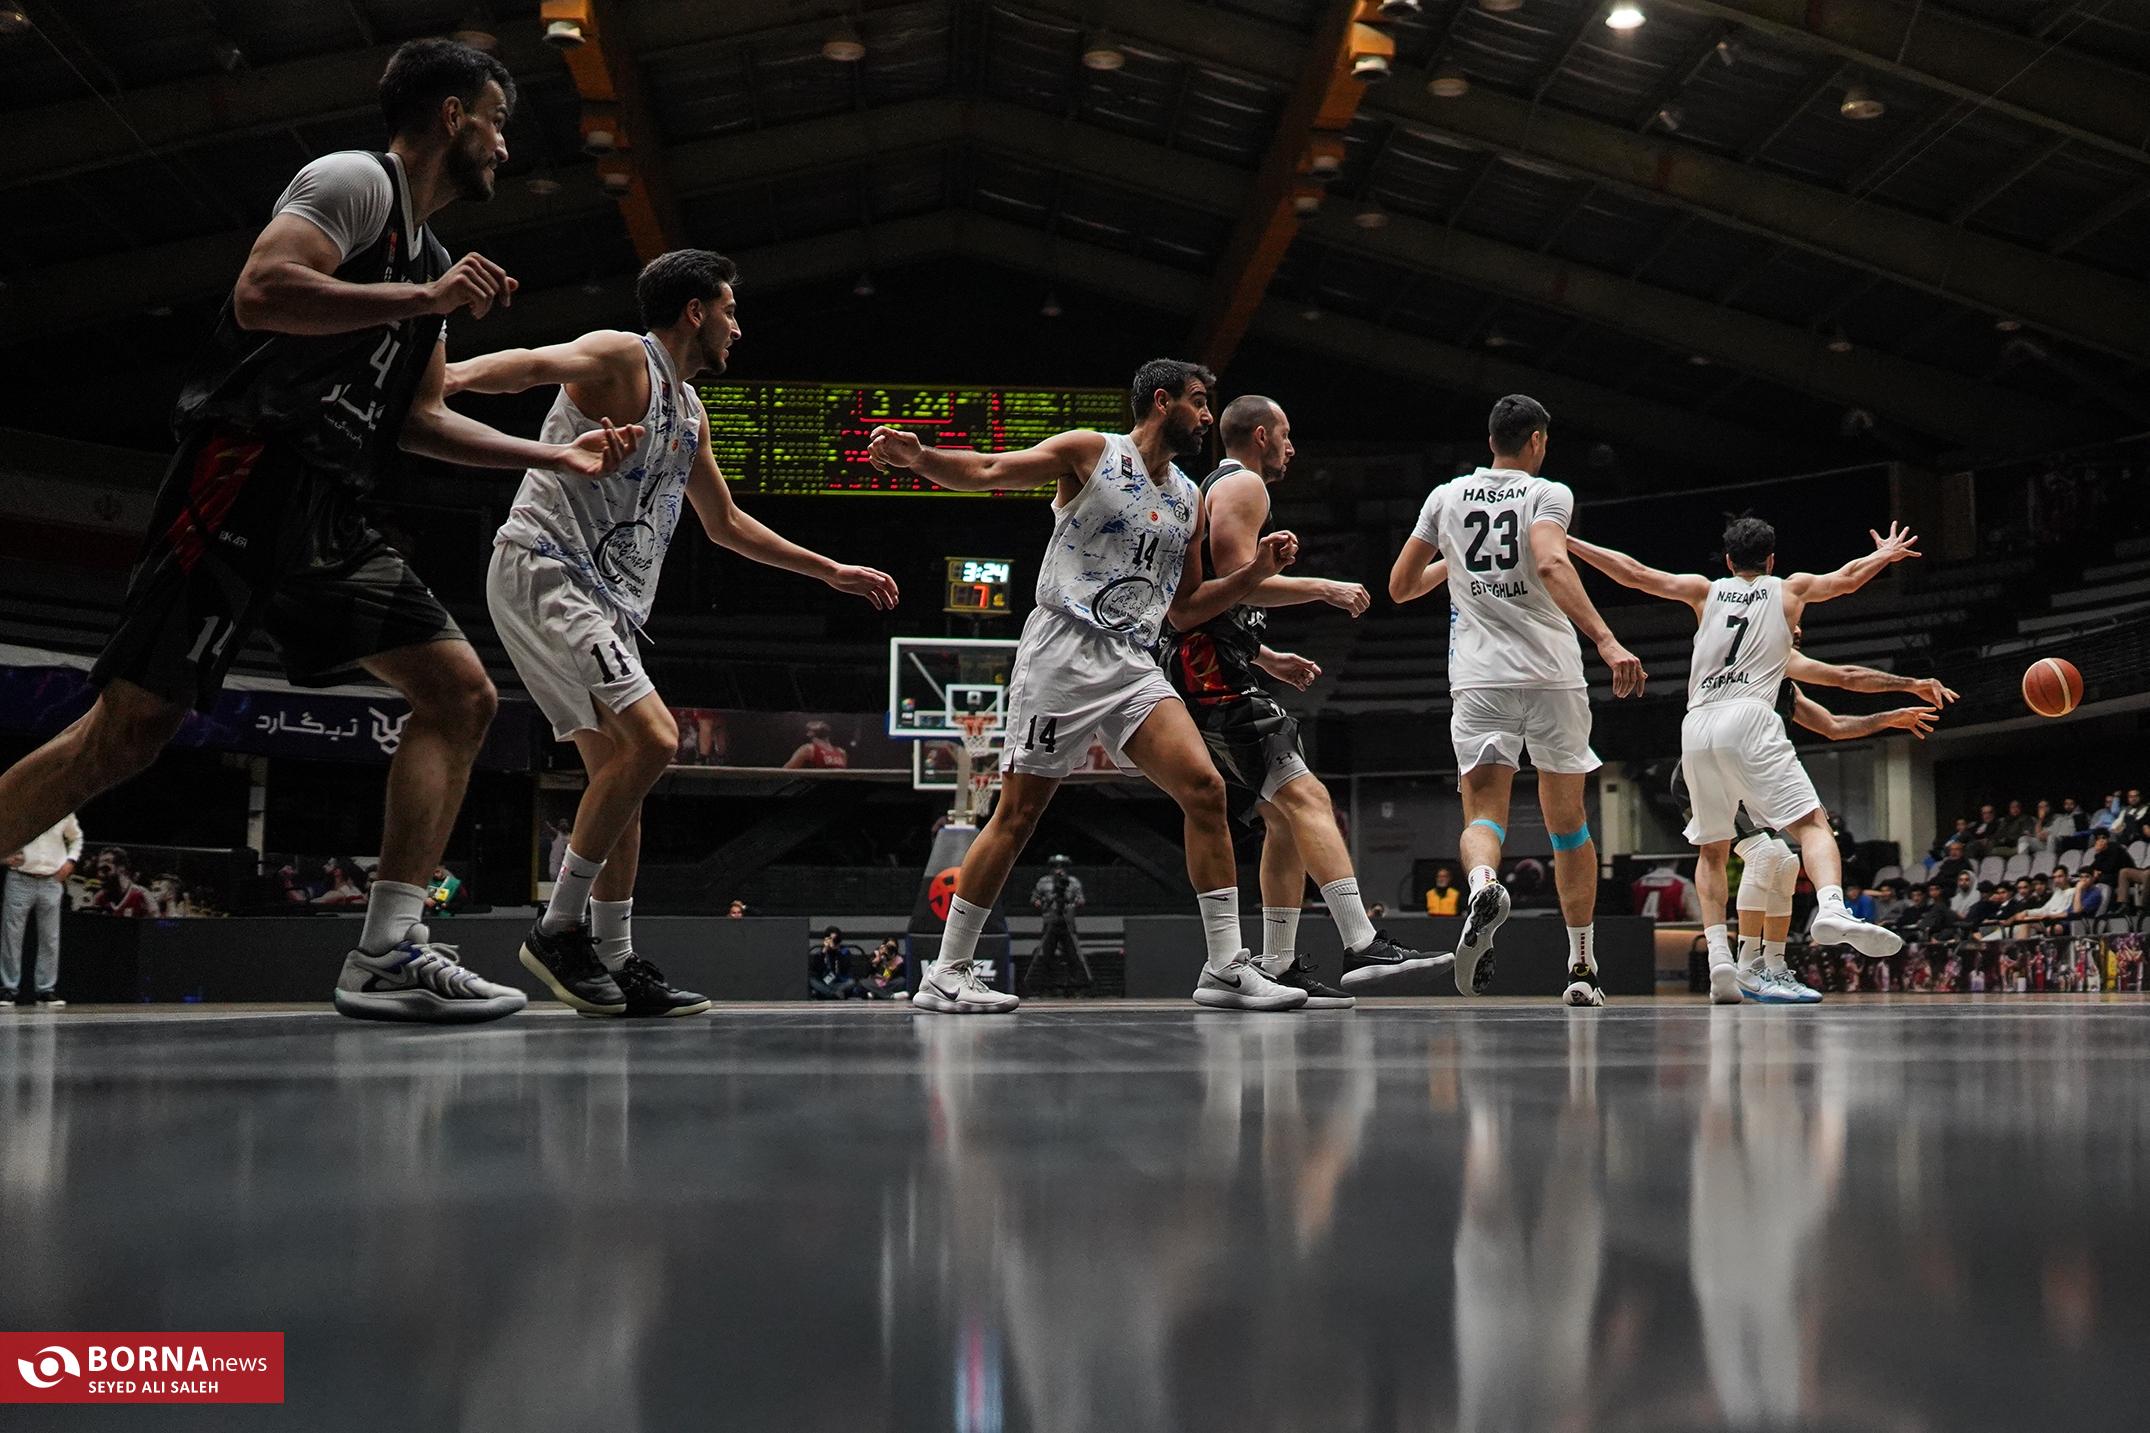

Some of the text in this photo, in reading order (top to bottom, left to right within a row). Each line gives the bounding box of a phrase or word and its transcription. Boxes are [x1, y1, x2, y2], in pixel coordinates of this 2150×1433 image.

[369, 330, 401, 389] 4
[1463, 486, 1527, 504] HASSAN
[1132, 532, 1160, 572] 14
[1464, 510, 1519, 572] 23
[962, 562, 1009, 583] 3:24
[973, 584, 990, 609] 7
[1726, 615, 1749, 667] 7
[591, 640, 632, 684] 11
[1701, 671, 1750, 690] ESTEHLAL
[1025, 714, 1058, 753] 14
